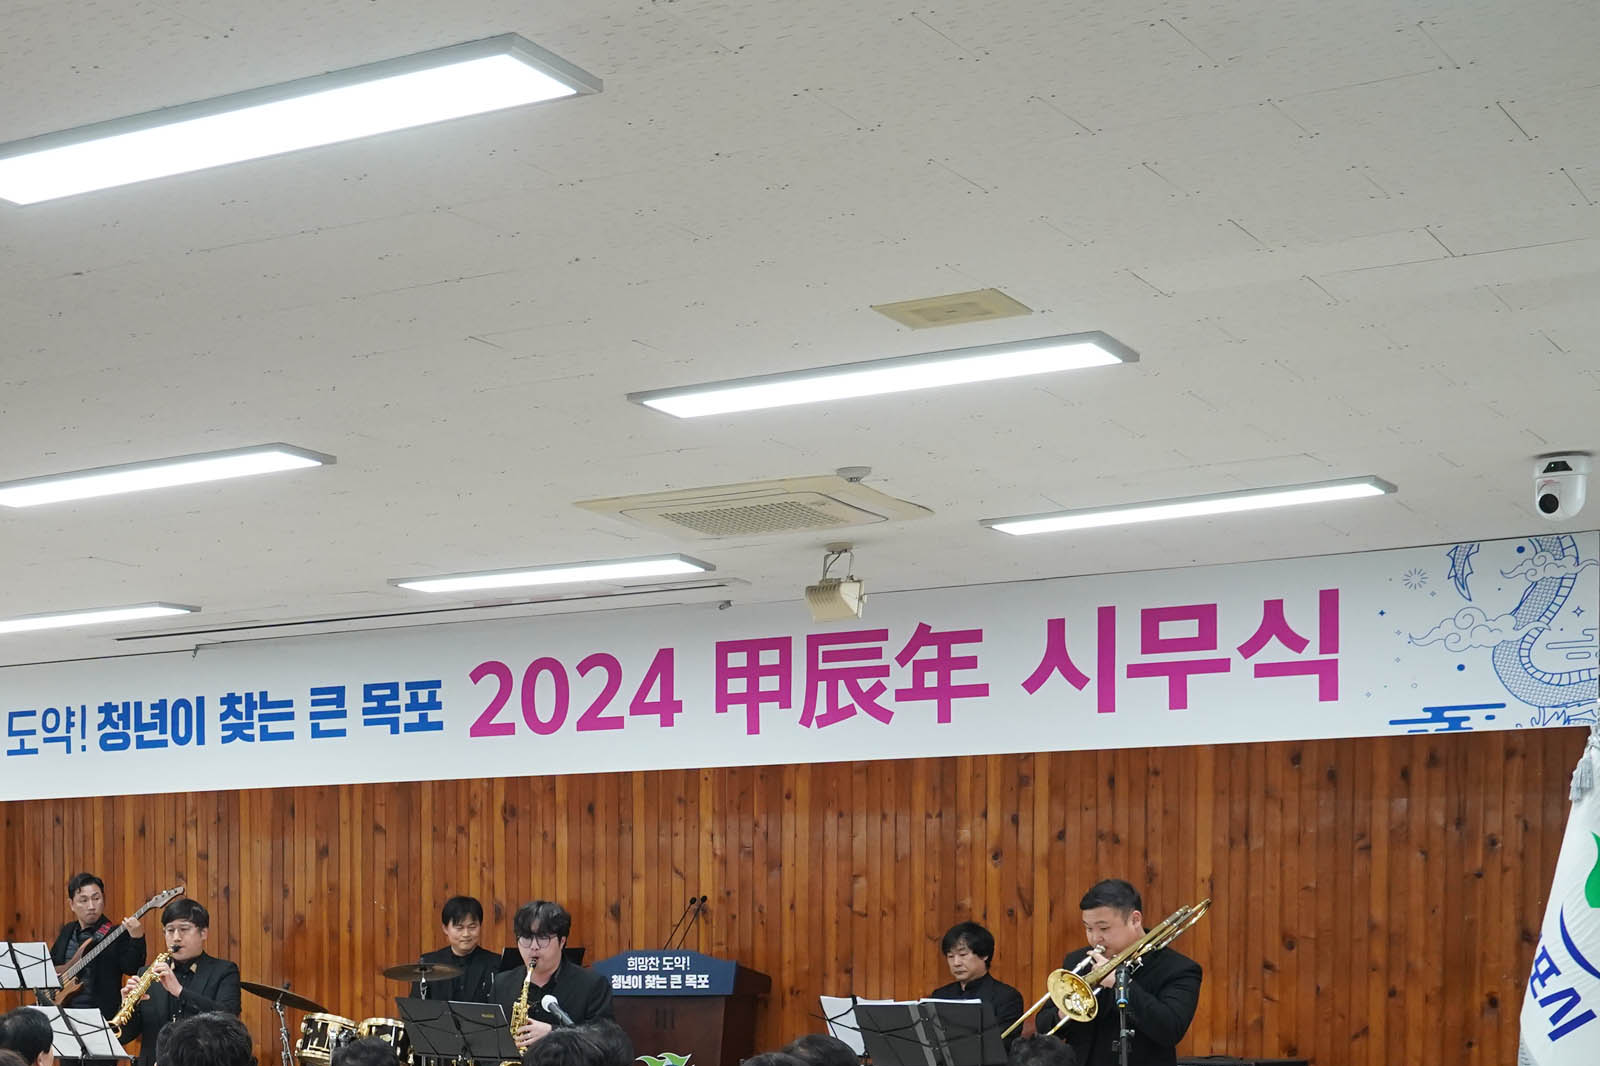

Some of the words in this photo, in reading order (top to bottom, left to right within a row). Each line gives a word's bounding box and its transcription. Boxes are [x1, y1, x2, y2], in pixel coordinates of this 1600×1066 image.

[469, 647, 683, 738] 2024
[715, 623, 990, 736] 甲辰年
[1021, 588, 1340, 714] 시무식
[7, 704, 87, 756] 도약!
[97, 695, 205, 752] 청년이
[219, 690, 295, 745] 찾는
[309, 685, 347, 740] 큰
[361, 679, 444, 736] 목포
[611, 974, 643, 990] 청년이
[645, 974, 668, 989] 찾는
[670, 974, 682, 989] 큰
[685, 974, 710, 989] 목포
[627, 956, 660, 972] 희망찬
[662, 956, 691, 971] 도약!
